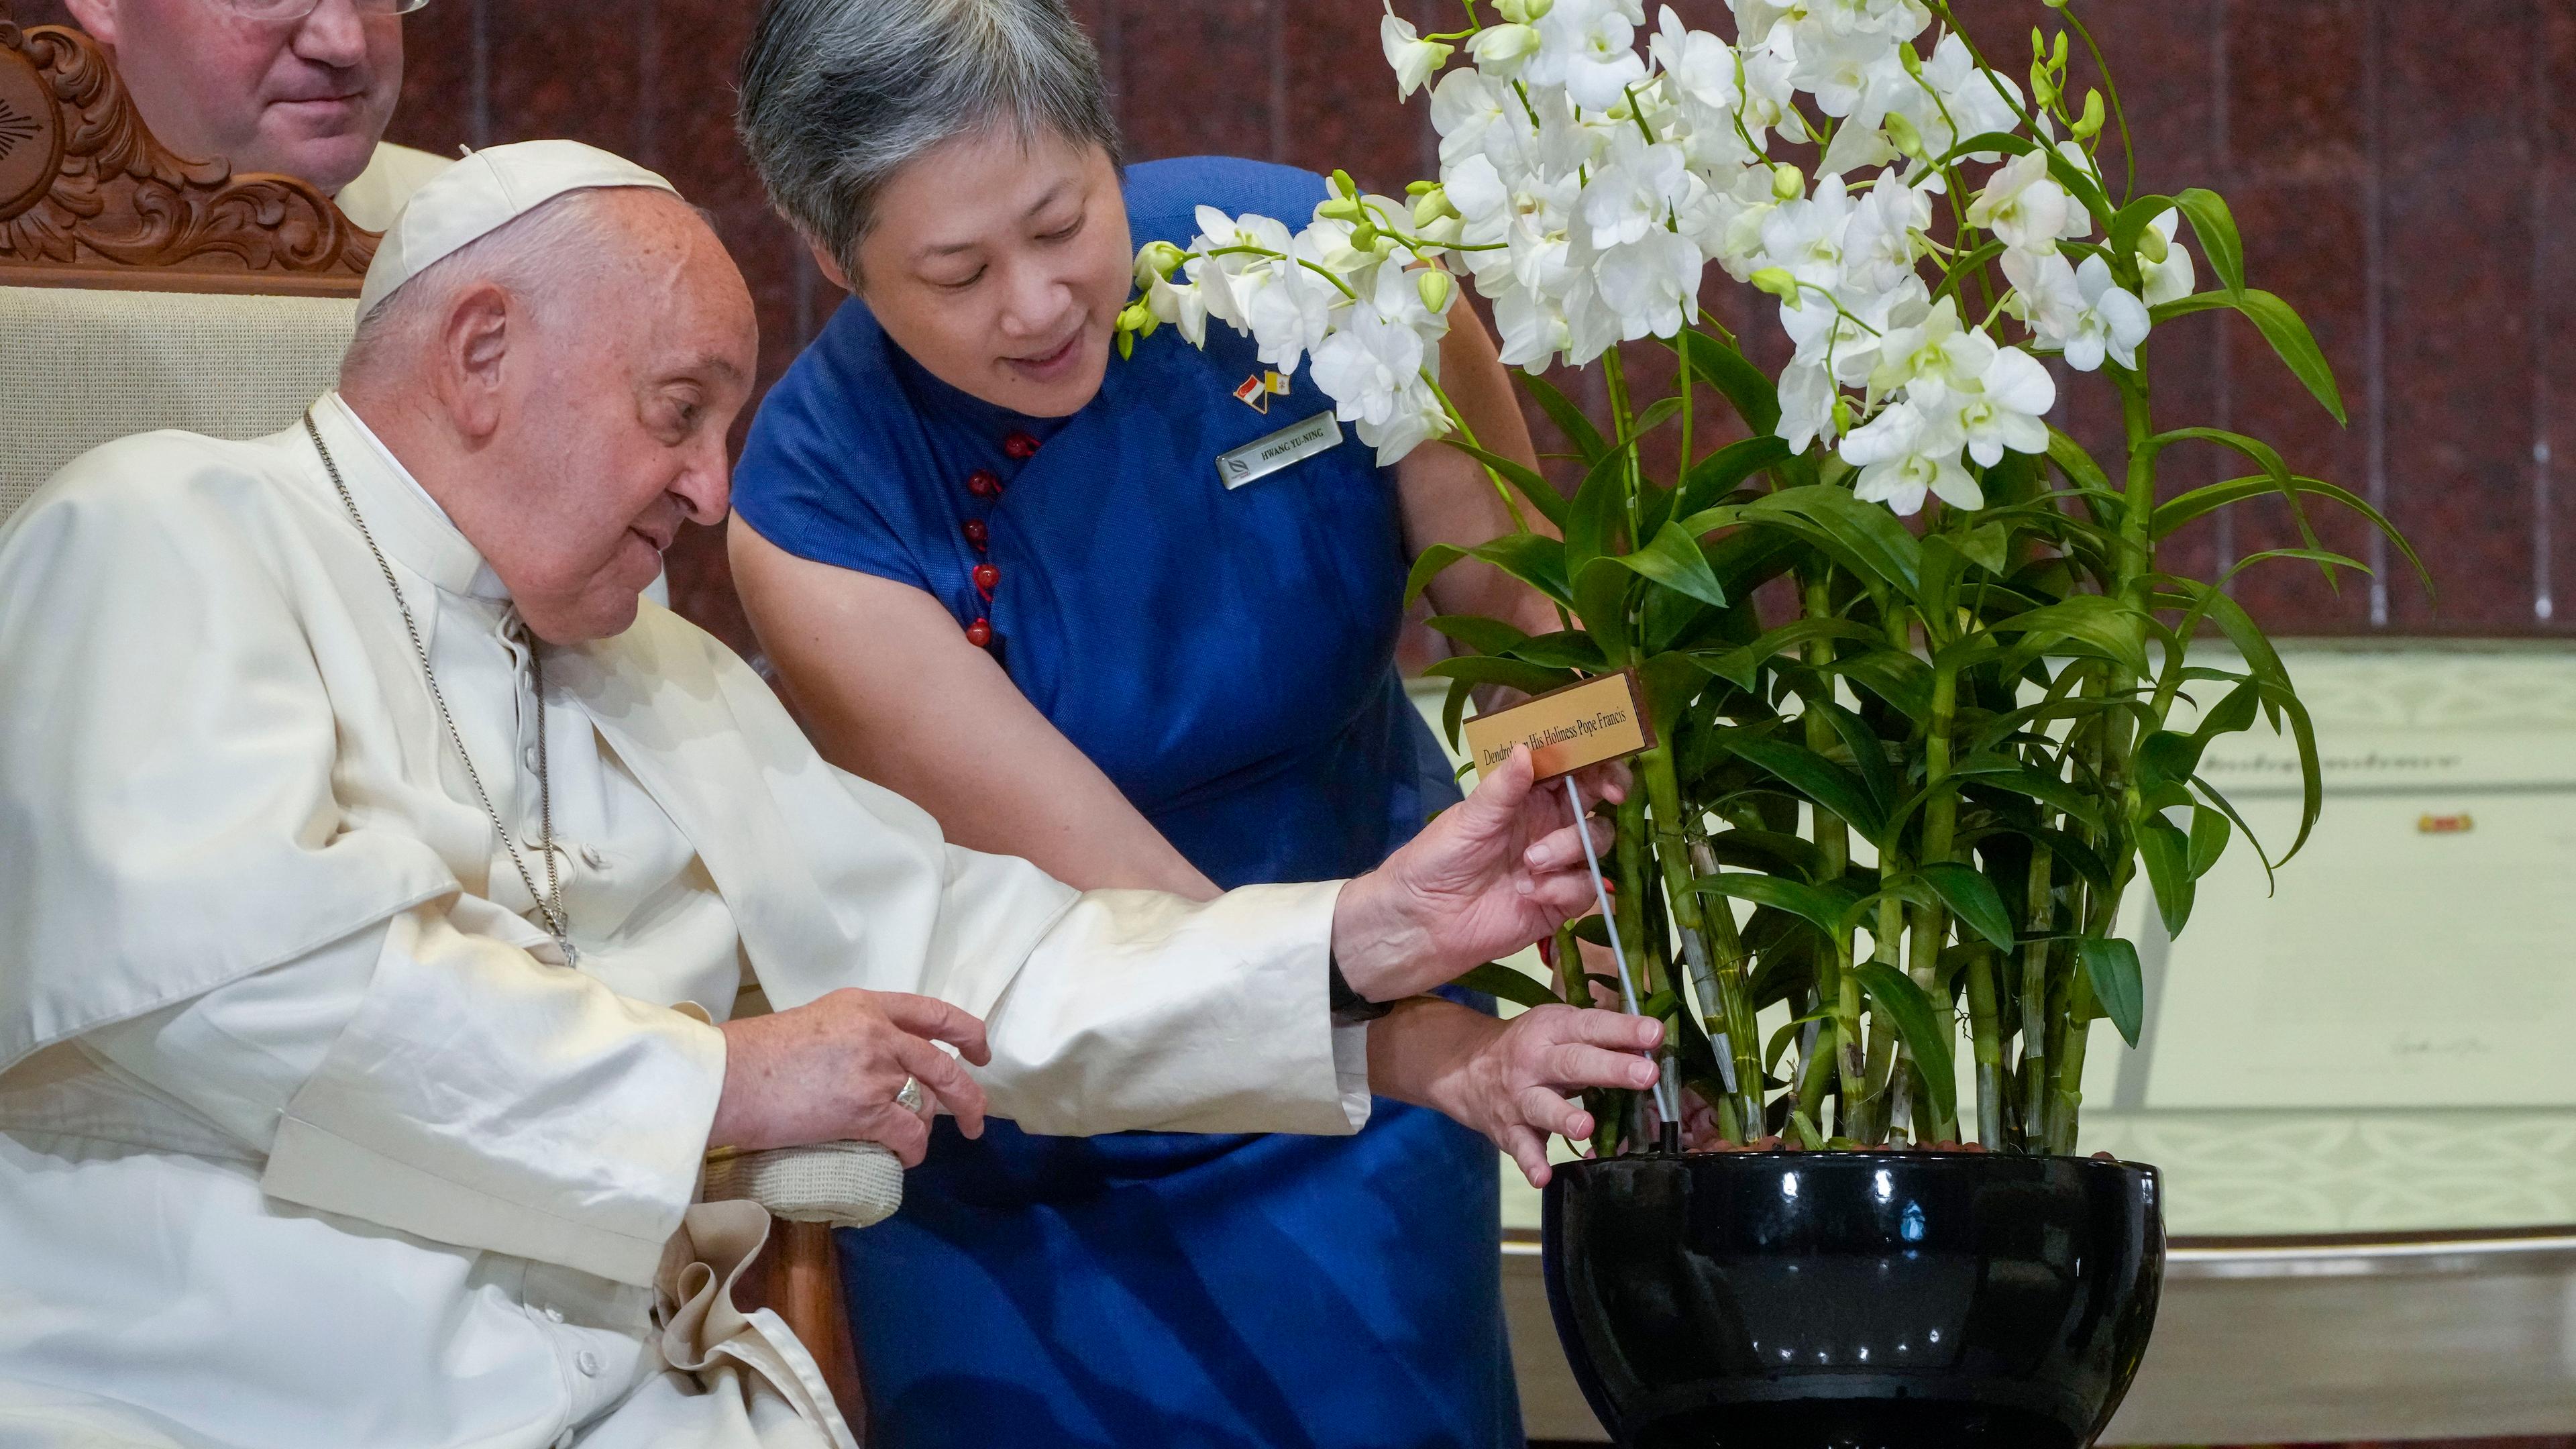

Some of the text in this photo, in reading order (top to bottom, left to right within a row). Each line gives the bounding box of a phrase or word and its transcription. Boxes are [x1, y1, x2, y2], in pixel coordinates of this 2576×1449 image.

[1261, 429, 1324, 460] HWANG YU-NING
[1483, 706, 1626, 765] Dendro His Holiness Pope Francis
